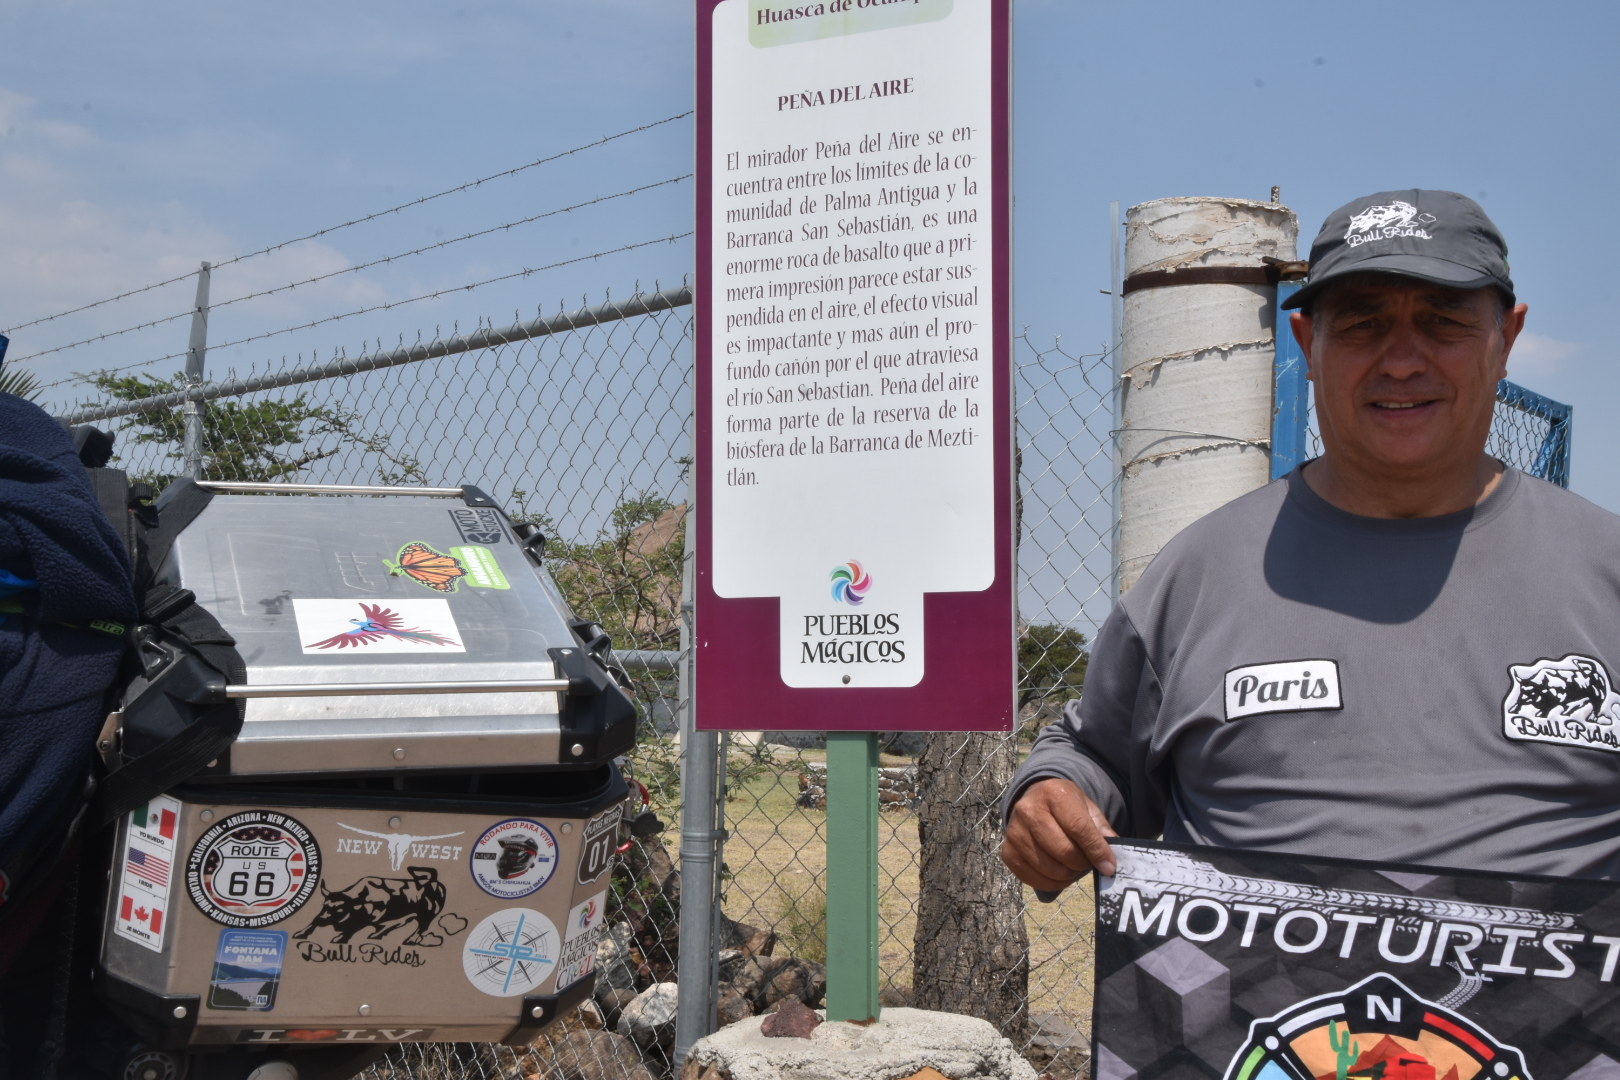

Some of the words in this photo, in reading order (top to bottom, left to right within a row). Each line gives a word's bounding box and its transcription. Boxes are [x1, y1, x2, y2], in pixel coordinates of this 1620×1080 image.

[757, 3, 824, 25] Huasca
[830, 0, 852, 13] de
[778, 89, 825, 111] PEÑA
[830, 86, 865, 104] DEL
[869, 77, 914, 97] AIRE
[726, 152, 739, 171] El
[747, 145, 808, 168] mirador
[816, 140, 851, 159] Peña
[859, 133, 881, 154] del
[888, 131, 920, 150] Aire
[928, 130, 943, 145] se
[952, 126, 977, 142] en-
[727, 176, 782, 196] cuentra
[787, 170, 827, 189] entre
[831, 166, 852, 184] los
[856, 161, 908, 182] límites
[913, 154, 931, 173] de
[936, 152, 949, 171] la
[955, 154, 977, 169] co-
[727, 198, 792, 223] munidad
[800, 196, 817, 214] de
[825, 191, 871, 212] Palma
[878, 185, 939, 206] Antigua
[947, 183, 956, 202] y
[964, 177, 977, 196] la
[727, 229, 793, 249] Barranca
[802, 223, 828, 241] San
[837, 213, 914, 237] Sebastián,
[923, 213, 938, 228] es
[947, 208, 977, 225] una
[1347, 227, 1383, 248] Bull
[727, 255, 782, 275] enorme
[787, 252, 818, 269] roca
[823, 246, 840, 265] de
[845, 241, 898, 263] basalto
[904, 240, 931, 261] que
[936, 239, 944, 254] a
[949, 234, 977, 257] pri-
[727, 285, 763, 302] mera
[769, 274, 843, 300] impresión
[848, 270, 897, 294] parece
[903, 265, 942, 284] estar
[947, 264, 977, 280] sus-
[727, 306, 784, 332] pendida
[789, 306, 806, 322] en
[812, 301, 823, 320] el
[828, 301, 860, 319] aire,
[864, 296, 876, 315] el
[881, 293, 927, 314] efecto
[933, 286, 978, 309] visual
[727, 339, 740, 354] es
[747, 332, 831, 355] impactante
[837, 332, 845, 349] y
[852, 328, 883, 343] mas
[890, 322, 918, 340] aún
[926, 318, 938, 337] el
[946, 320, 978, 340] pro-
[726, 360, 770, 380] fundo
[775, 356, 820, 377] cañón
[825, 357, 851, 377] por
[856, 351, 868, 370] el
[873, 351, 901, 373] que
[907, 346, 978, 366] atraviesa
[727, 388, 738, 406] el
[743, 386, 763, 405] río
[767, 387, 793, 404] San
[798, 382, 873, 401] Sebastian.
[880, 378, 917, 395] Peña
[922, 372, 944, 392] del
[949, 374, 979, 390] aire
[726, 414, 771, 434] forma
[779, 413, 819, 434] parte
[827, 408, 844, 426] de
[852, 406, 865, 425] la
[873, 407, 929, 423] reserva
[939, 400, 957, 419] de
[965, 398, 979, 418] la
[727, 438, 785, 459] biósfera
[789, 437, 806, 455] de
[812, 435, 824, 454] la
[830, 434, 900, 454] Barranca
[905, 430, 922, 448] de
[928, 428, 980, 447] Mezti-
[726, 467, 759, 486] tlán.
[454, 510, 483, 532] MOTO
[475, 510, 501, 532] STUCKE
[803, 613, 899, 636] PUEBLOS
[1233, 670, 1329, 707] Paris
[1511, 716, 1566, 738] Bull
[191, 826, 223, 862] CALIFORNIA
[227, 813, 260, 824] ARIZONA
[267, 814, 284, 824] NEW
[284, 819, 309, 842] MEXICO
[305, 844, 318, 866] TEXAS
[337, 838, 382, 855] NEW
[412, 844, 462, 861] WEST
[480, 823, 518, 846] RODANDO
[520, 822, 539, 833] PARA
[540, 830, 554, 848] VIVIR
[231, 846, 279, 856] ROUTE
[242, 861, 251, 869] U
[258, 861, 266, 870] S
[589, 835, 609, 872] 01
[229, 871, 275, 896] 66
[478, 874, 492, 889] AMIGOS
[491, 886, 532, 896] MOTOCICLISTAS
[533, 876, 544, 887] BMW
[189, 872, 210, 912] OKLAHOMA
[211, 909, 245, 926] KANSAS
[250, 906, 294, 926] MISSOURI
[296, 874, 317, 907] ILLINOIS
[133, 928, 150, 940] MONTE
[224, 946, 277, 955] FONTANA
[297, 941, 357, 963] Bull
[1367, 995, 1401, 1023] N
